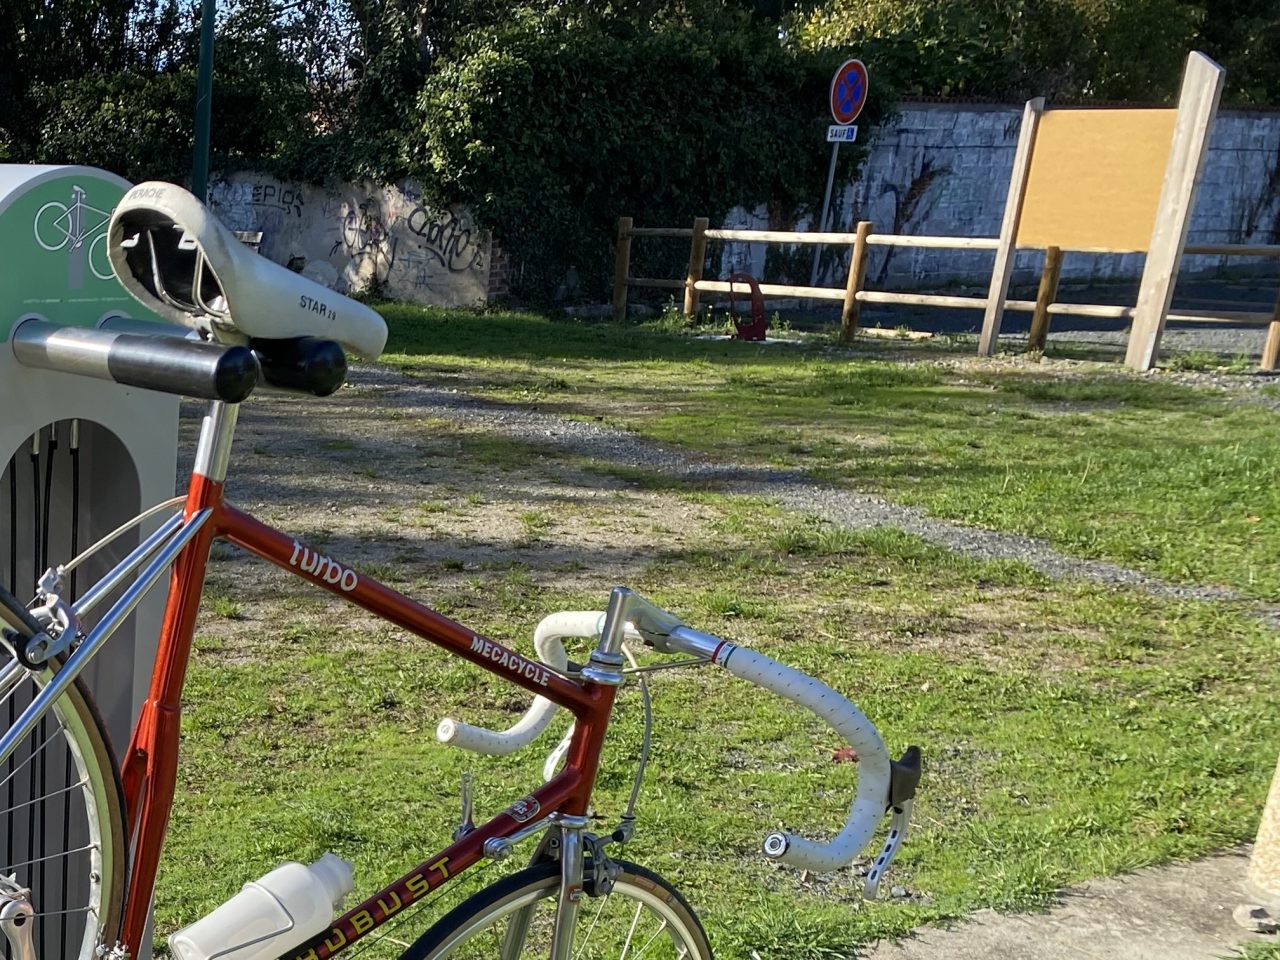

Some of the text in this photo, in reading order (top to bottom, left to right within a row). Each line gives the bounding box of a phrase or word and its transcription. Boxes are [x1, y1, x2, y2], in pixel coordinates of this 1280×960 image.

[829, 128, 847, 138] SAUF
[299, 294, 327, 317] STAR
[469, 635, 552, 687] MECACYCLE
